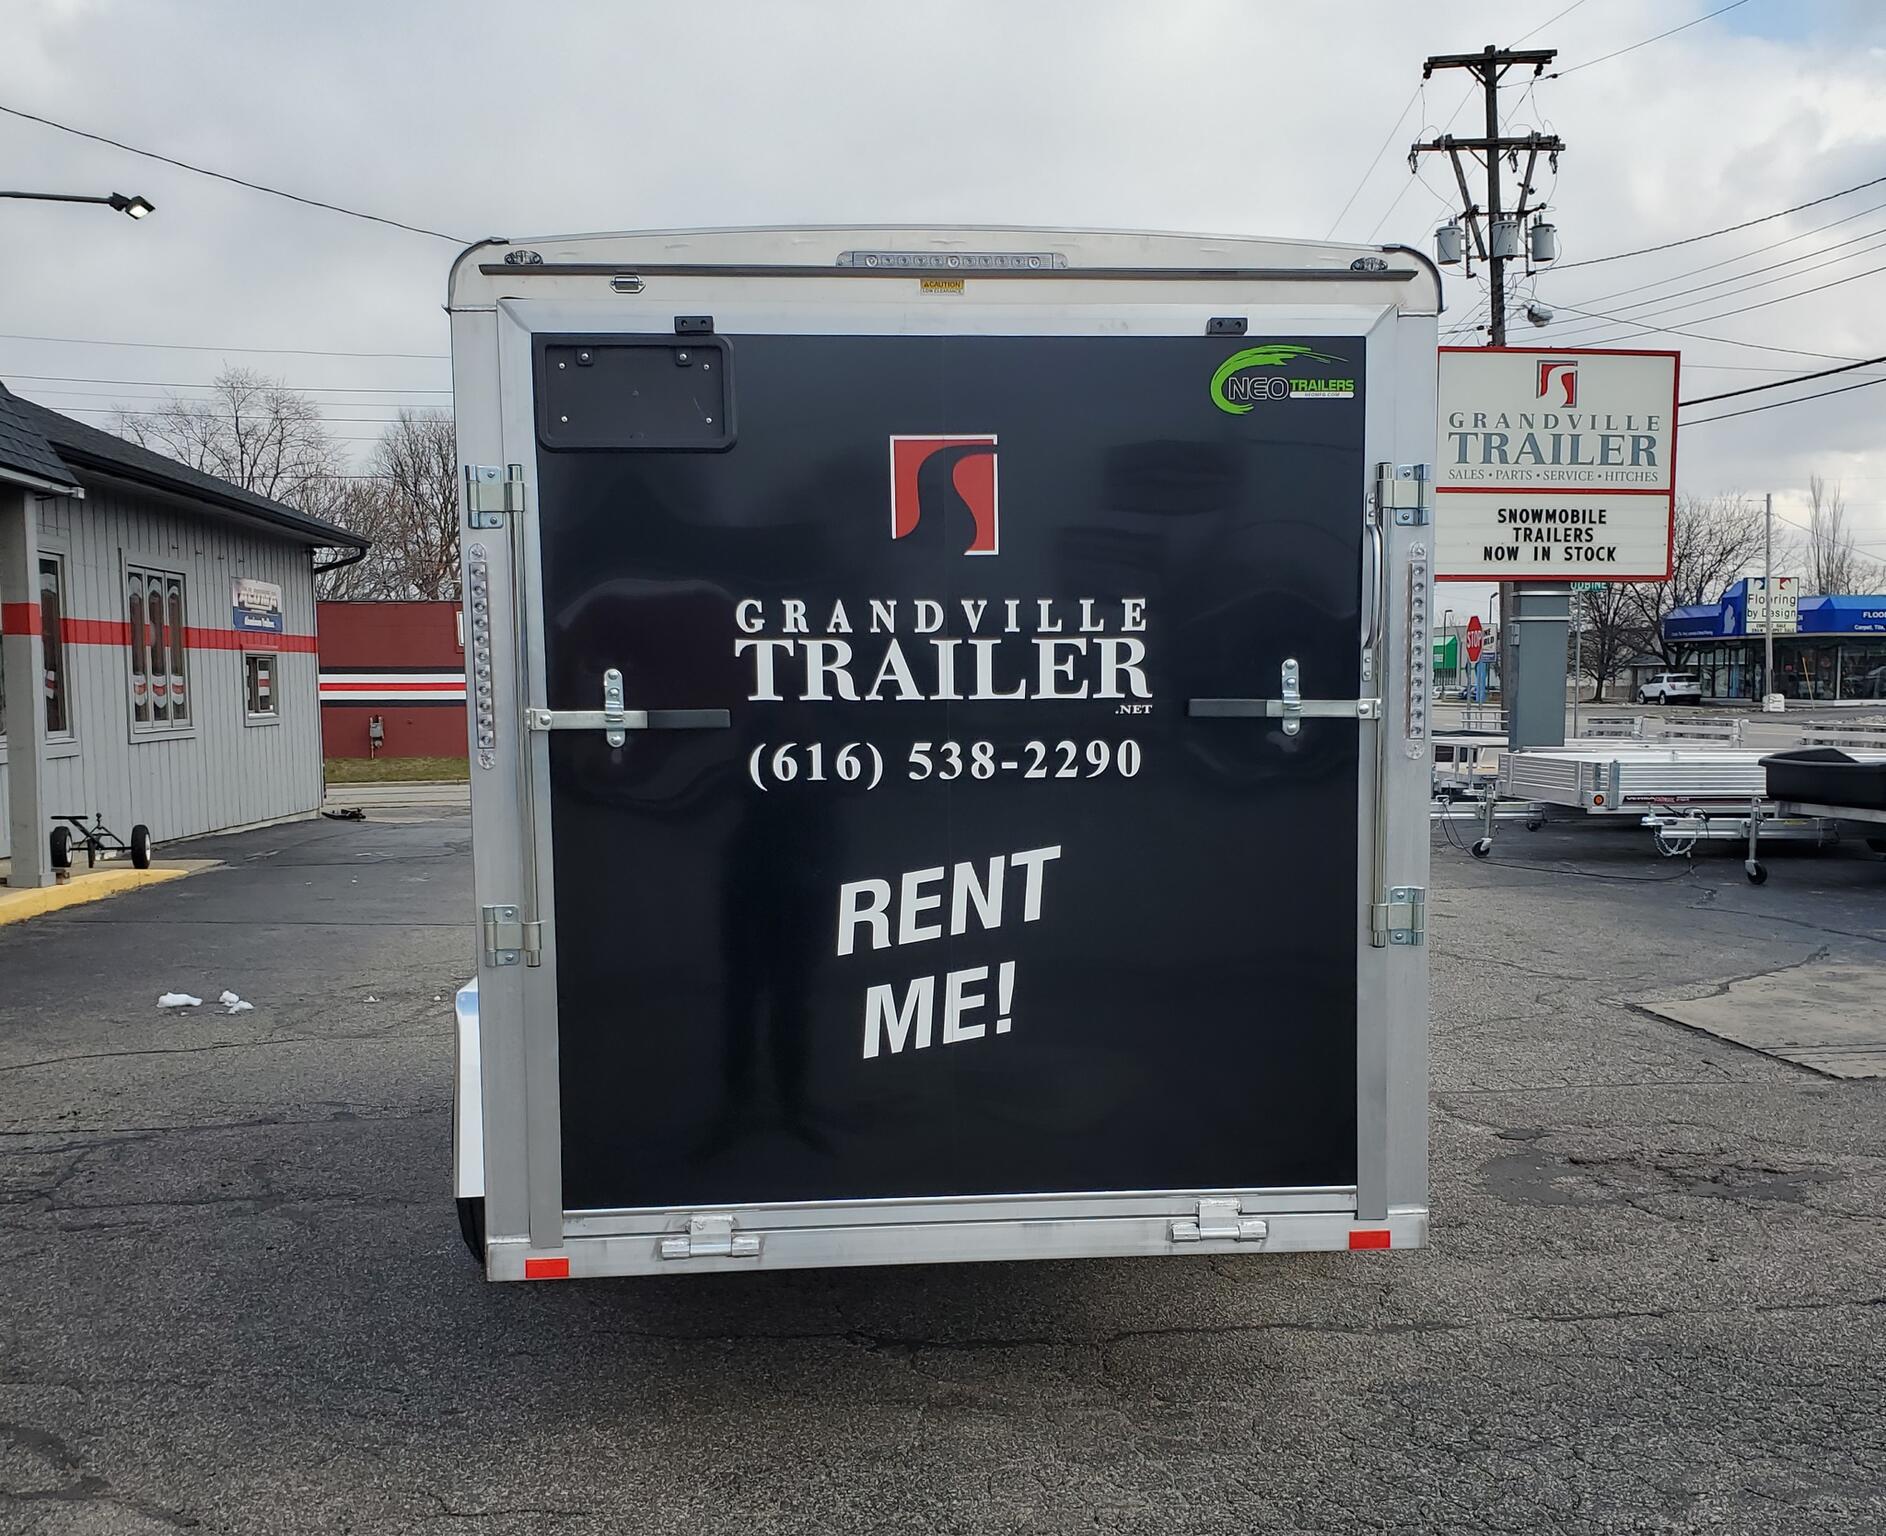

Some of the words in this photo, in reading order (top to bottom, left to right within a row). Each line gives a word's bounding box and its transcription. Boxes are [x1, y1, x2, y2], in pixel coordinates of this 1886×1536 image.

[1228, 377, 1289, 400] NEO
[1290, 379, 1354, 391] TRAILERS
[1449, 411, 1660, 431] GRANDVILLE
[1448, 432, 1658, 467] TRAILER
[1448, 469, 1485, 480] SALES
[1496, 470, 1533, 480] PARTS
[1543, 470, 1594, 481] SERVICE
[1605, 471, 1658, 482] HITCHES
[1498, 508, 1607, 525] SNOWMOBILE
[1513, 527, 1594, 543] TRAILERS
[1483, 546, 1519, 561] NOW
[1533, 546, 1551, 561] IN
[1564, 546, 1616, 562] STOCK
[1748, 594, 1796, 607] Floring
[735, 597, 1147, 634] GRANDVILLE
[1747, 608, 1758, 619] by
[1467, 630, 1482, 648] STOP
[734, 637, 1153, 701] TRAILER
[1115, 704, 1153, 715] .NET
[749, 742, 885, 791] (616)
[908, 739, 1141, 780] 538-2290
[837, 845, 1061, 957] RENT
[863, 960, 1016, 1059] ME!
